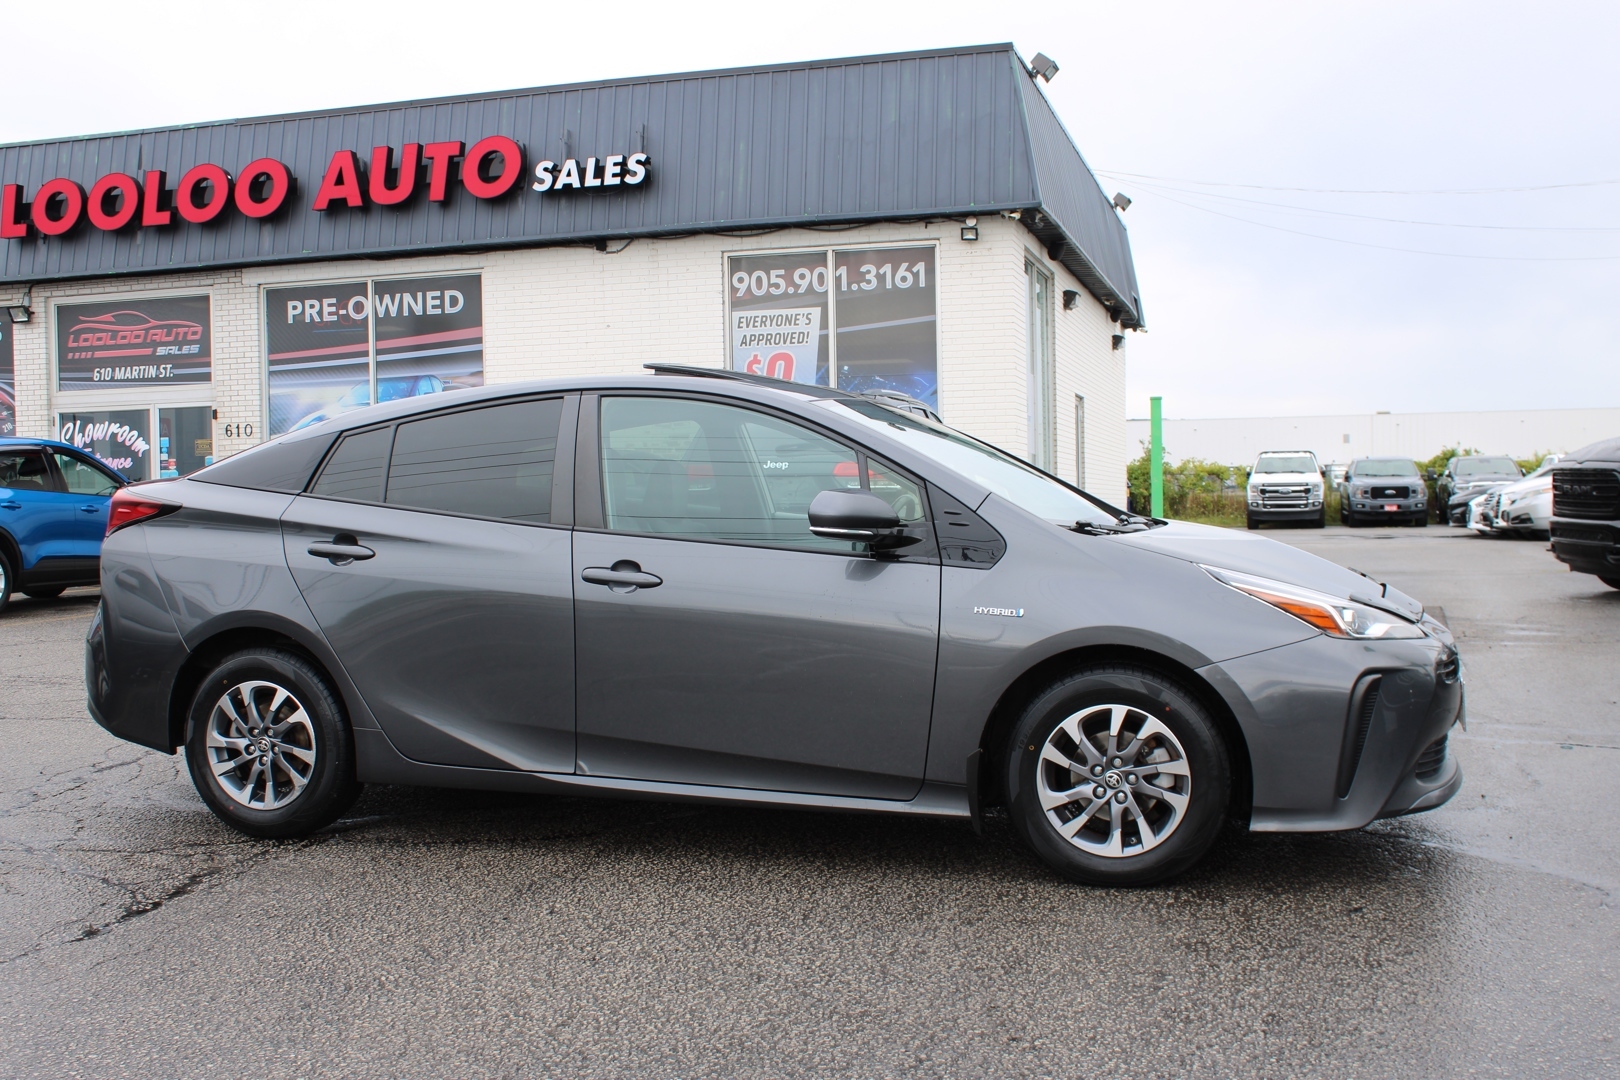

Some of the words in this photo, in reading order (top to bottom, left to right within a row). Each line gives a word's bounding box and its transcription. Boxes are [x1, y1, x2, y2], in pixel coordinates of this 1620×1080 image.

[1, 157, 291, 239] LOOLOO
[312, 135, 524, 211] AUTO
[532, 153, 649, 192] SALES
[732, 261, 926, 297] 905.901.3161
[287, 289, 464, 324] PRE-OWNED
[737, 312, 812, 329] EVERYONE'S
[67, 331, 145, 347] LOOLOO
[146, 327, 203, 342] AUTO
[739, 331, 810, 347] APPROVED!
[155, 344, 200, 355] SALES
[93, 367, 112, 381] 610
[114, 365, 157, 380] MARTIN
[158, 364, 174, 378] ST.
[225, 423, 253, 437] 610
[763, 460, 789, 470] Jeep
[974, 606, 1016, 616] HYBRID
